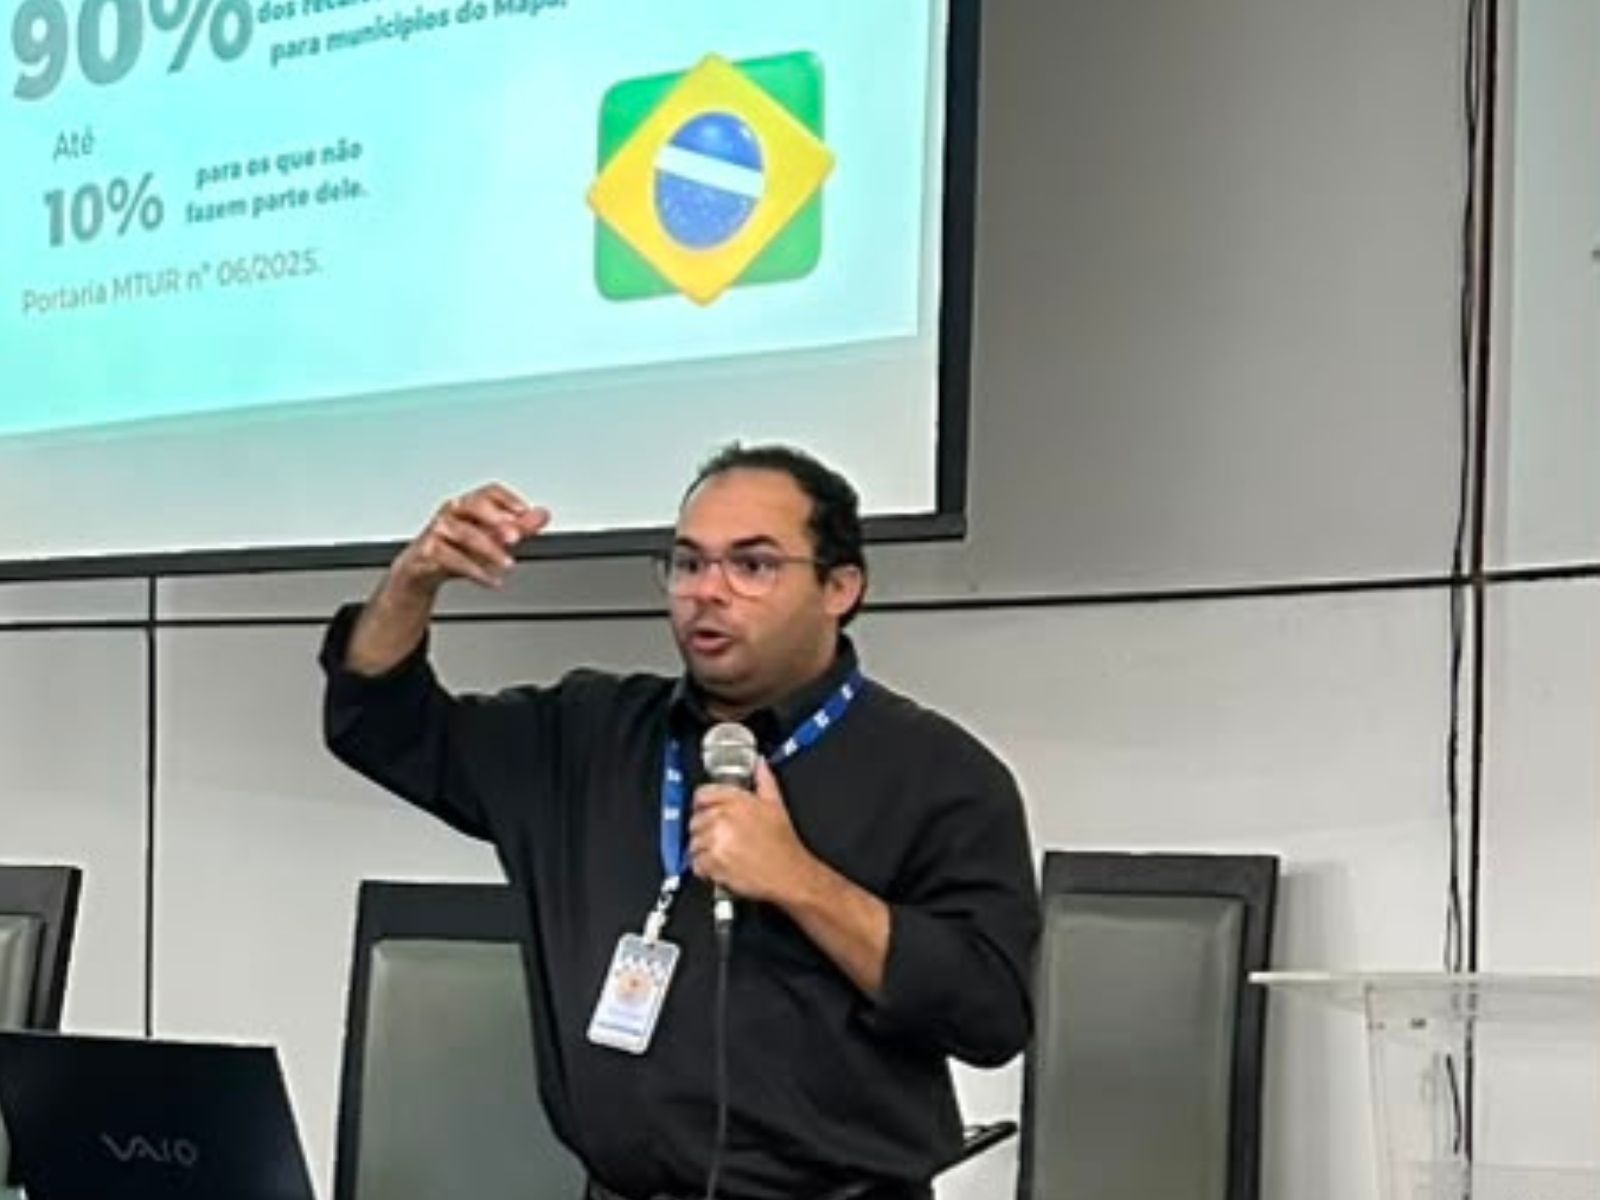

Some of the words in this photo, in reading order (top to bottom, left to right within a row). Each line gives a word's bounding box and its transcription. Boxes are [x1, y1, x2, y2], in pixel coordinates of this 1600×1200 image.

[11, 0, 253, 100] 90%
[270, 37, 320, 67] para
[455, 0, 487, 23] do
[53, 125, 95, 161] Até
[195, 163, 242, 190] para
[247, 158, 271, 177] os
[275, 149, 316, 175] que
[320, 137, 363, 165] não
[43, 172, 164, 247] 10%
[185, 197, 248, 223] fazem
[253, 187, 309, 218] parte
[22, 284, 108, 315] Portaria
[112, 267, 182, 301] MTUR
[100, 1132, 197, 1168] VAIO
